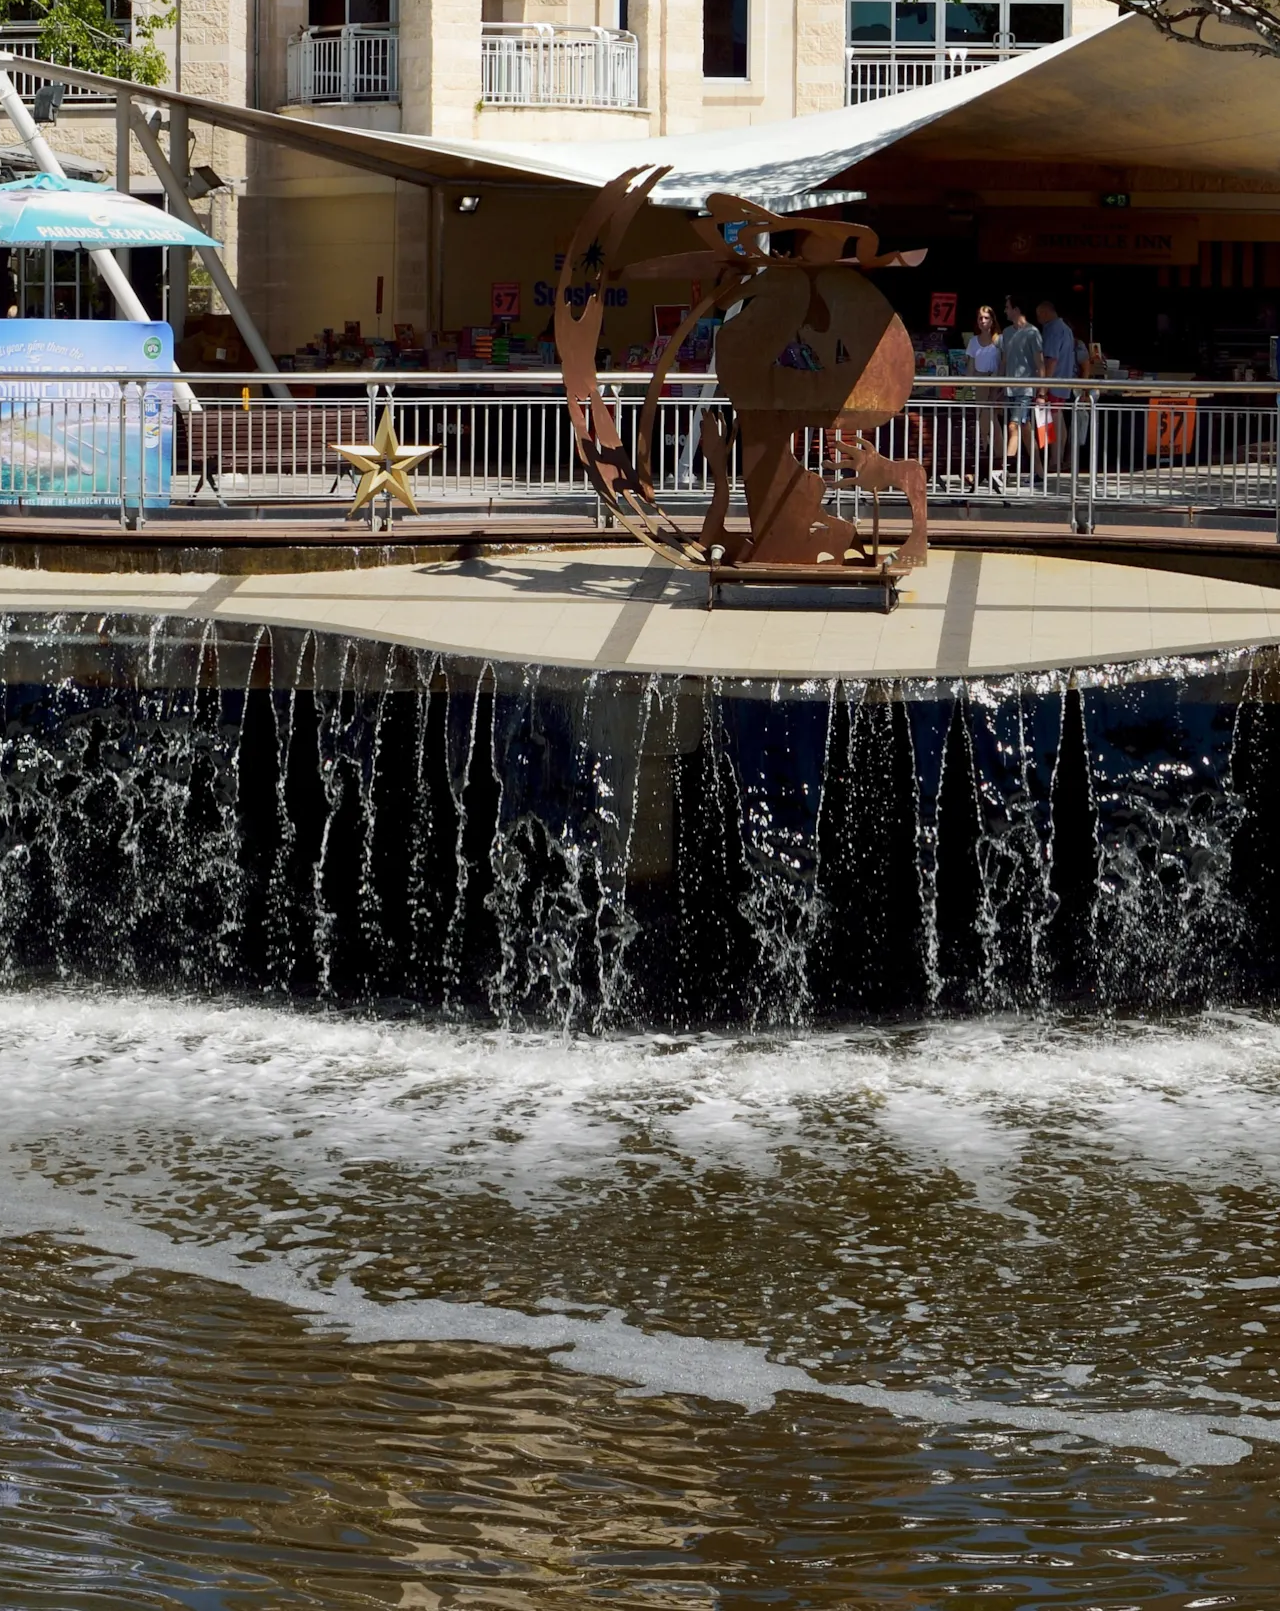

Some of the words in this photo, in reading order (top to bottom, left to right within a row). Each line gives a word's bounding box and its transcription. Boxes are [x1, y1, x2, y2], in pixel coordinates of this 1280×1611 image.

[36, 226, 108, 239] PARADISE
[107, 228, 186, 242] SEAPLANES
[494, 292, 517, 312] $7
[534, 281, 628, 307] Sunshne
[933, 302, 955, 323] $7
[68, 496, 102, 505] MAROOCHY
